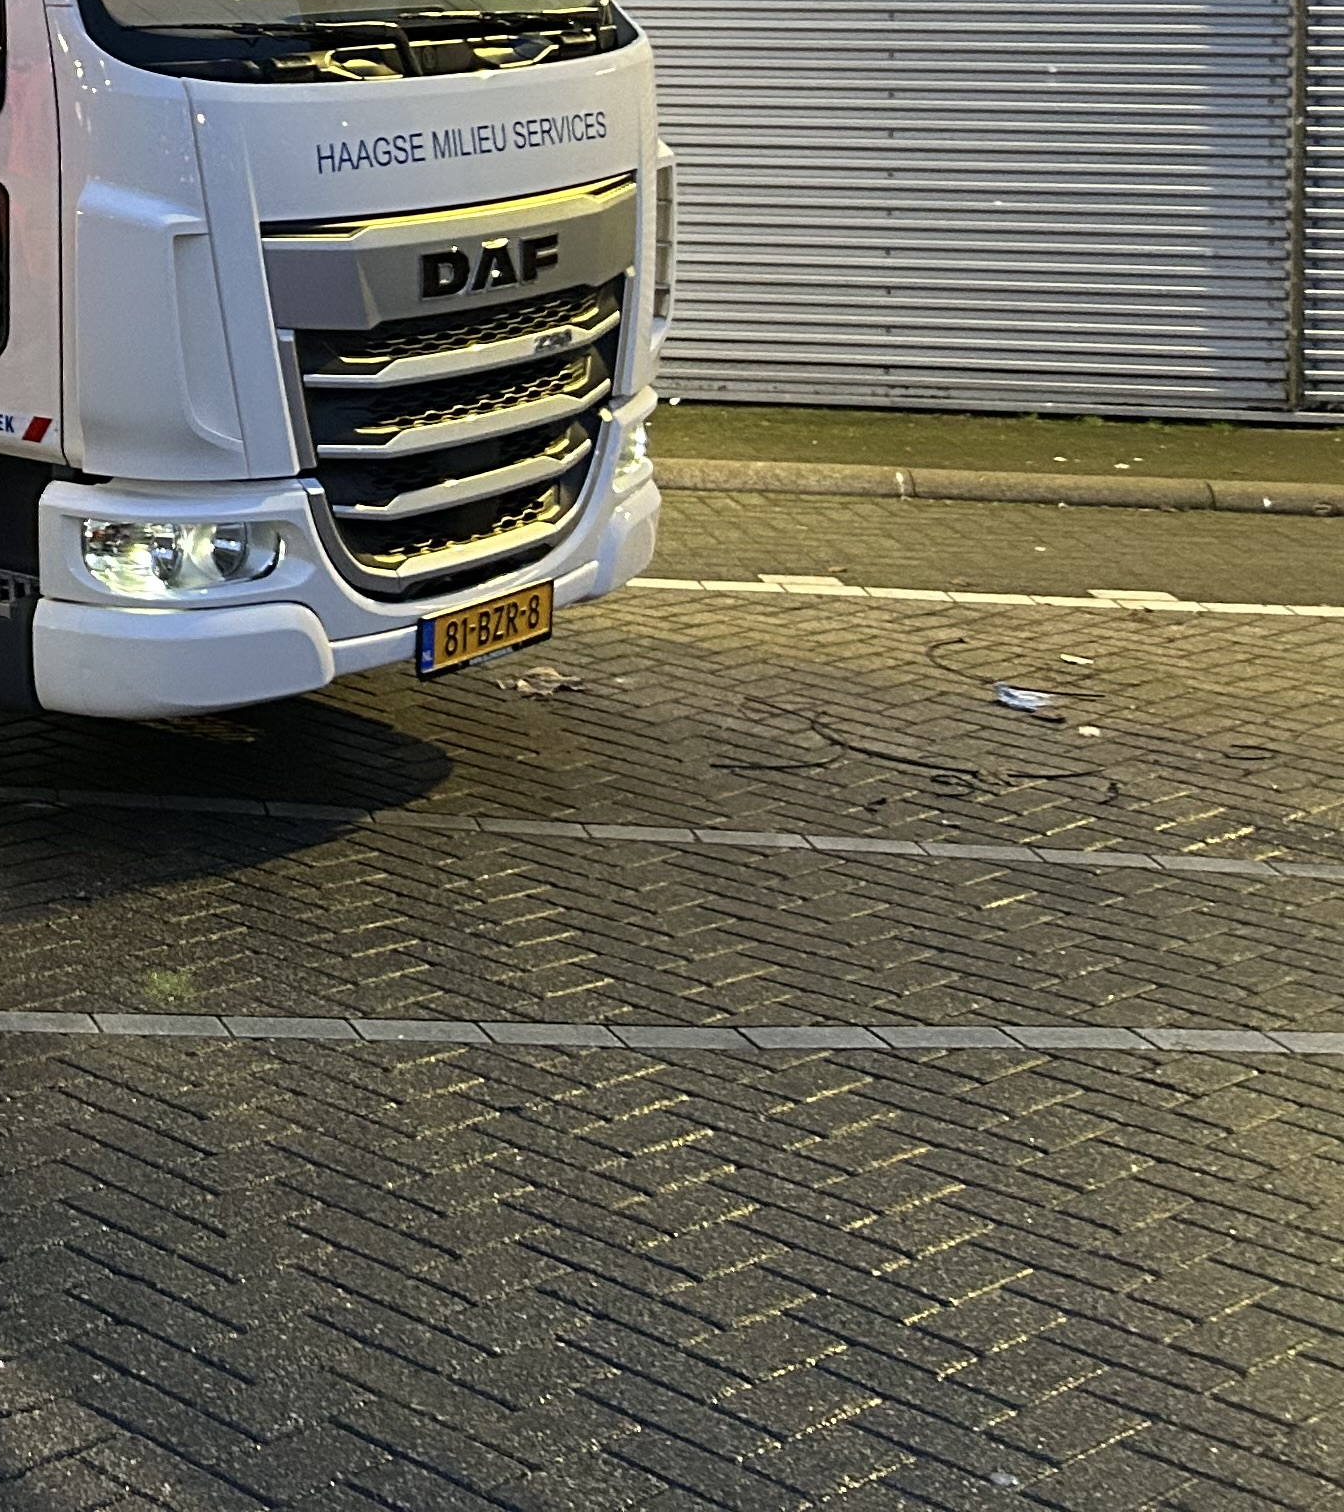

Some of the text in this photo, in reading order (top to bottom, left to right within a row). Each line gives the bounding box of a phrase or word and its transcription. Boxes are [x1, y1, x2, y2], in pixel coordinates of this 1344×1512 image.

[316, 111, 607, 174] HAAGSE MILIEU SERVICES
[420, 233, 559, 301] DAF
[444, 594, 540, 657] 81-BZR-8
